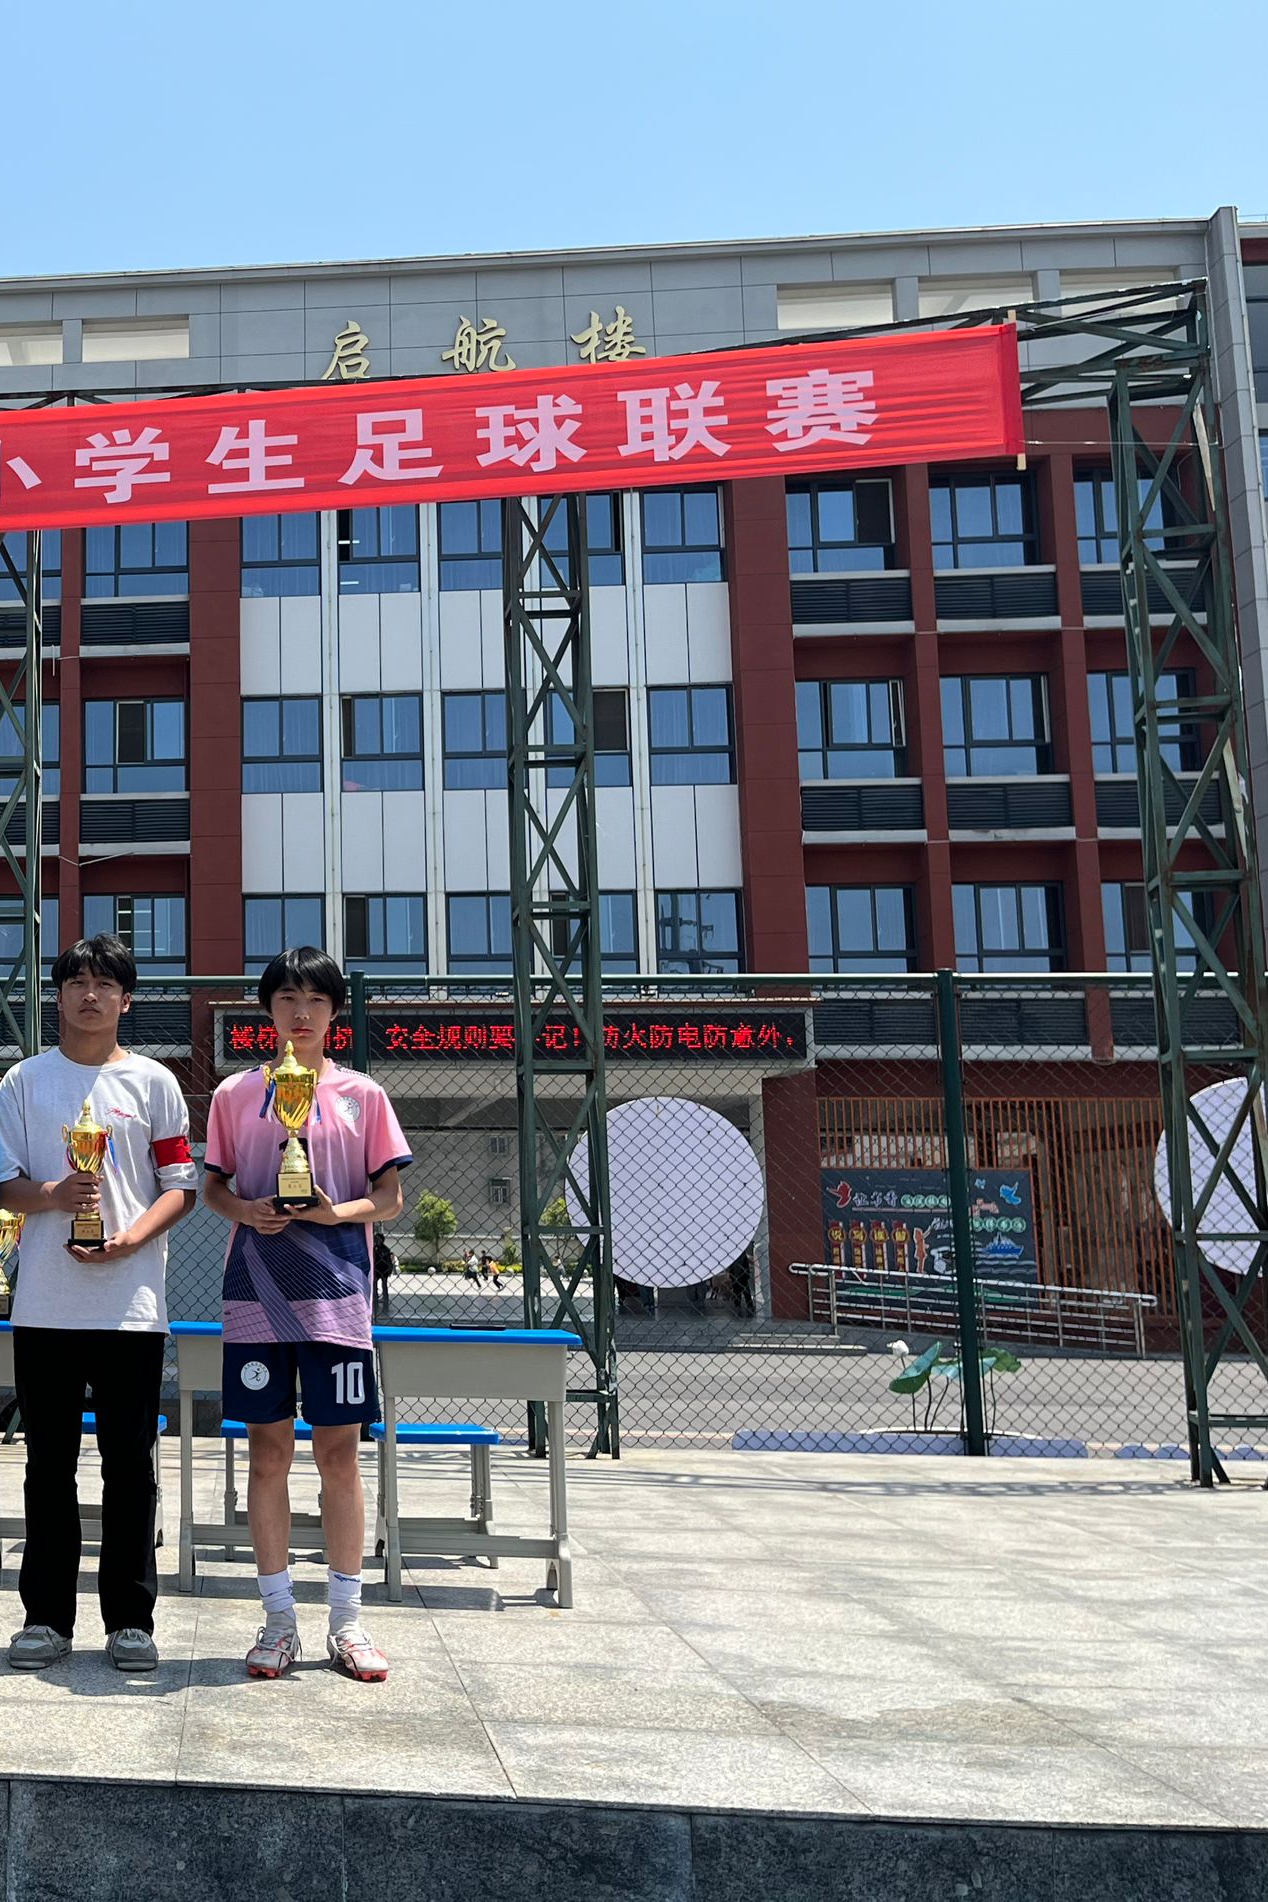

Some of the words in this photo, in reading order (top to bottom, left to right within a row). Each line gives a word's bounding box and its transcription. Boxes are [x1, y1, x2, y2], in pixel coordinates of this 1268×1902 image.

[320, 304, 647, 381] 启航楼
[331, 1362, 366, 1405] 10
